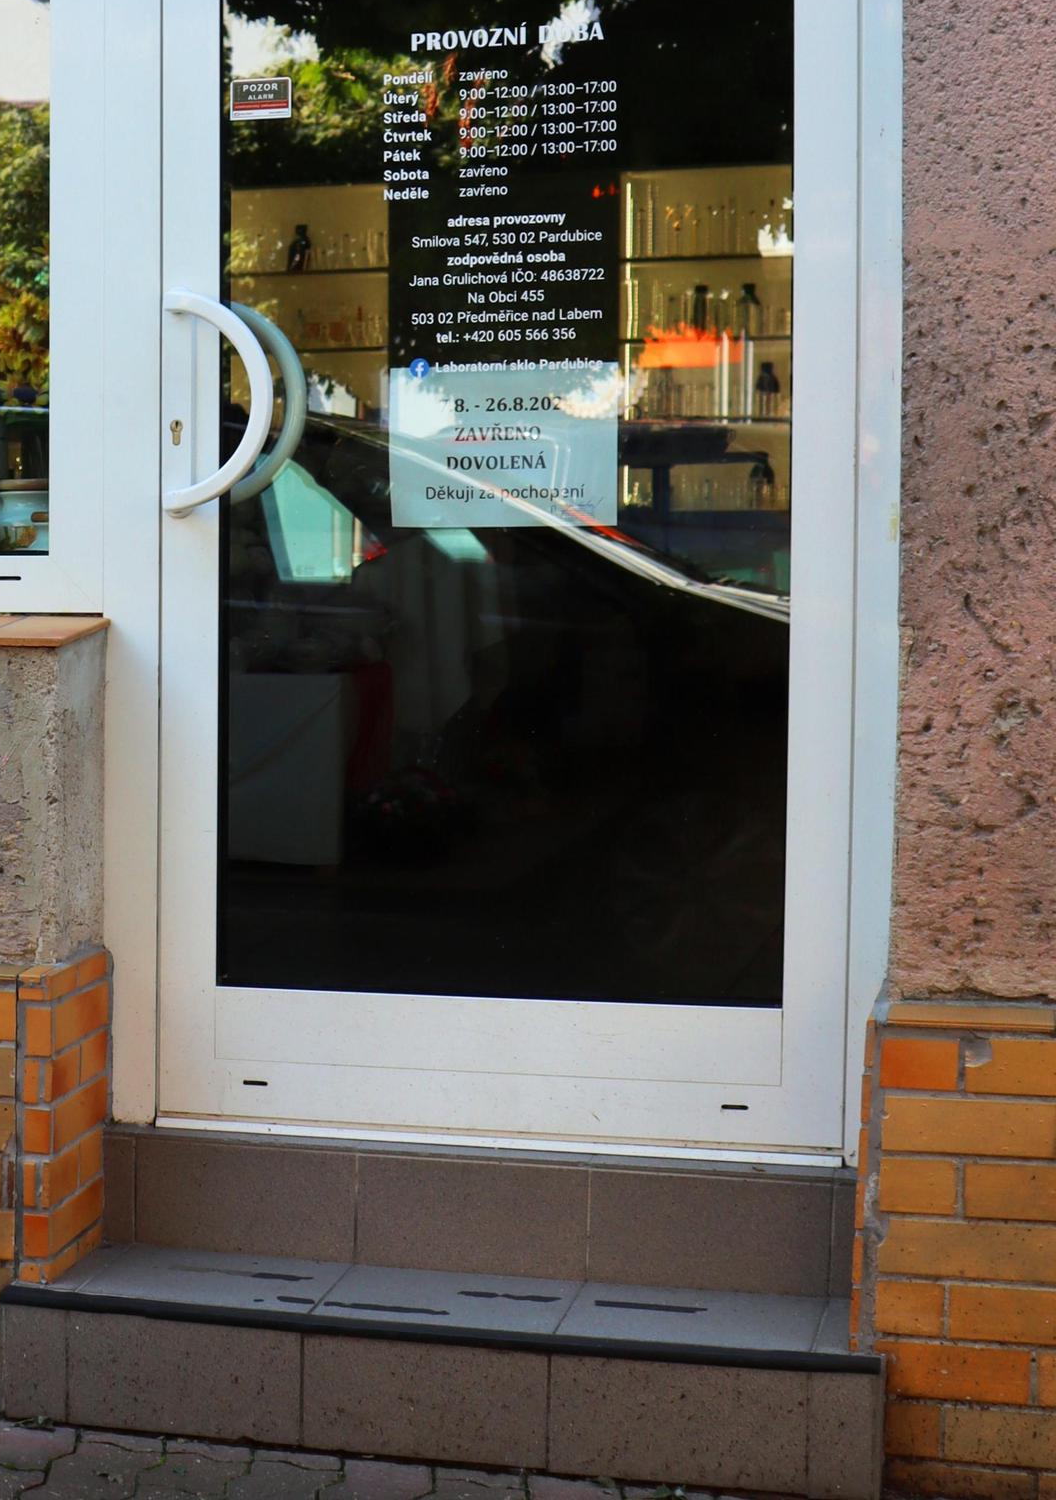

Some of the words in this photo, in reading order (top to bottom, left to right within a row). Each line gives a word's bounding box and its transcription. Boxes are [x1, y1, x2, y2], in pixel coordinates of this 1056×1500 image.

[411, 22, 527, 51] PROVOZNÍ
[383, 70, 433, 86] Pondělí
[459, 67, 508, 82] zavřeno
[242, 83, 278, 92] POZOR
[383, 91, 419, 106] Úterý
[530, 84, 537, 99] /
[383, 111, 427, 125] Středa
[530, 104, 537, 118] /
[383, 129, 432, 144] Čtvrtek
[530, 124, 537, 138] /
[383, 149, 421, 162] Pátek
[530, 143, 537, 158] /
[383, 169, 430, 182] Sobota
[459, 165, 508, 179] zavřeno
[383, 188, 430, 201] Neděle
[459, 184, 508, 198] zavřeno
[447, 215, 490, 227] adresa
[493, 213, 566, 228] provozovny
[411, 236, 460, 249] Smilova
[464, 234, 489, 248] 547,
[492, 233, 515, 245] 530
[519, 232, 536, 244] 02
[539, 229, 602, 244] Pardubice
[447, 251, 523, 267] zodpovědná
[527, 251, 566, 264] osoba
[409, 274, 439, 287] Jana
[443, 271, 508, 286] Grulichová
[511, 269, 537, 283] IČO:
[541, 268, 605, 282] 48638722
[467, 292, 485, 304] Na
[489, 290, 517, 303] Obci
[521, 290, 544, 302] 455
[411, 313, 434, 325] 503
[438, 312, 454, 324] 02
[457, 309, 529, 324] Předměřice
[532, 309, 555, 322] nad
[559, 308, 603, 321] Labem
[436, 331, 460, 344] tel.:
[463, 330, 494, 343] +420
[498, 329, 521, 341] 605
[525, 329, 549, 340] 566
[553, 328, 576, 340] 356
[435, 360, 506, 373] Laboratorní
[510, 358, 536, 371] sklo
[539, 357, 603, 371] Pardubice
[485, 396, 563, 412] 26.8.202
[455, 422, 542, 442] ZAVŘENO
[446, 451, 546, 470] DOVOLENÁ
[425, 486, 474, 503] Děkuji
[479, 489, 494, 499] za
[500, 484, 585, 502] pochopení
